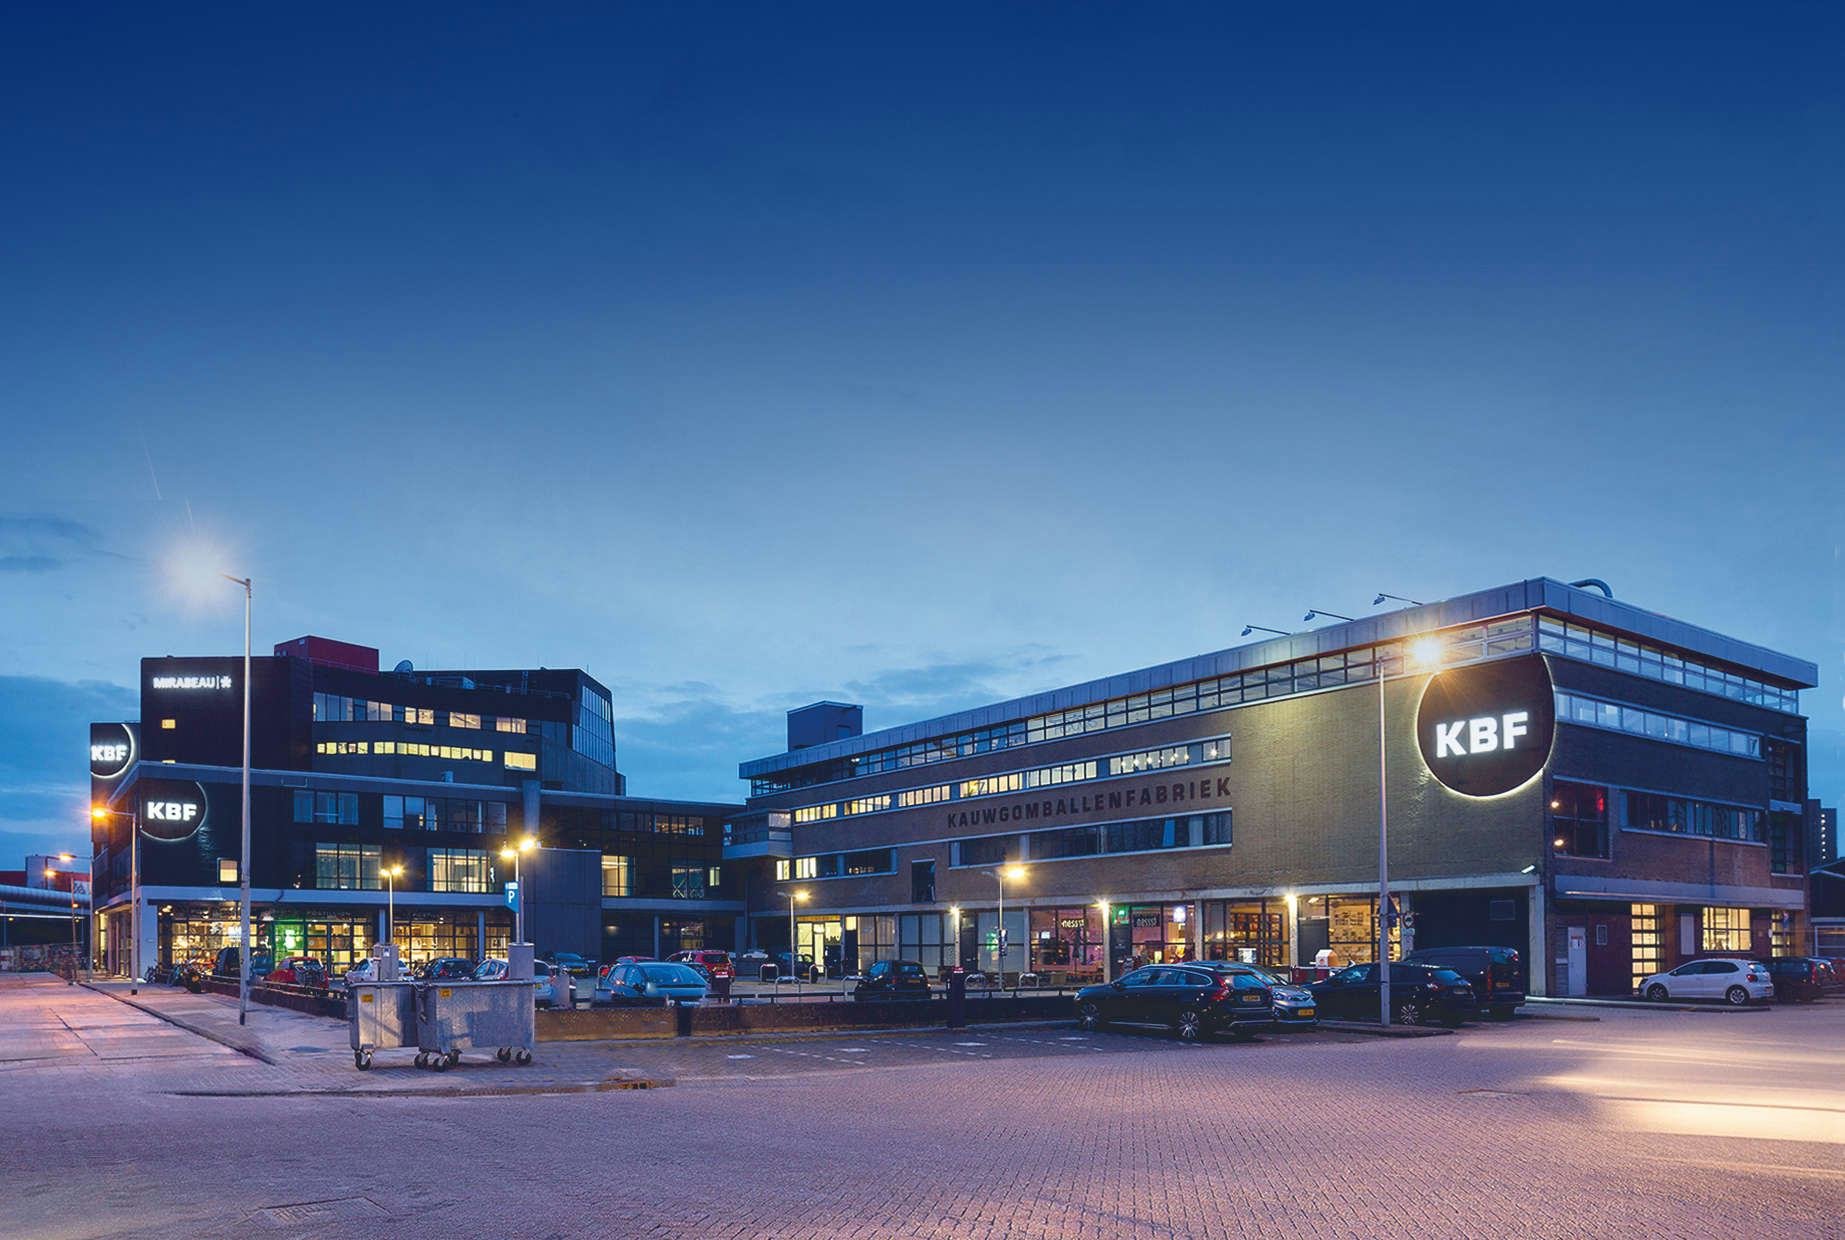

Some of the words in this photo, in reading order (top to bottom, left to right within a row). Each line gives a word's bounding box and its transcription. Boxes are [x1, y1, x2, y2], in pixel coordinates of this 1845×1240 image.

[1436, 712, 1528, 758] KBF
[91, 745, 127, 761] KBF
[147, 802, 197, 821] KBF
[947, 777, 1231, 829] KAUWGOMBALLENFABRIEK
[508, 890, 516, 903] P
